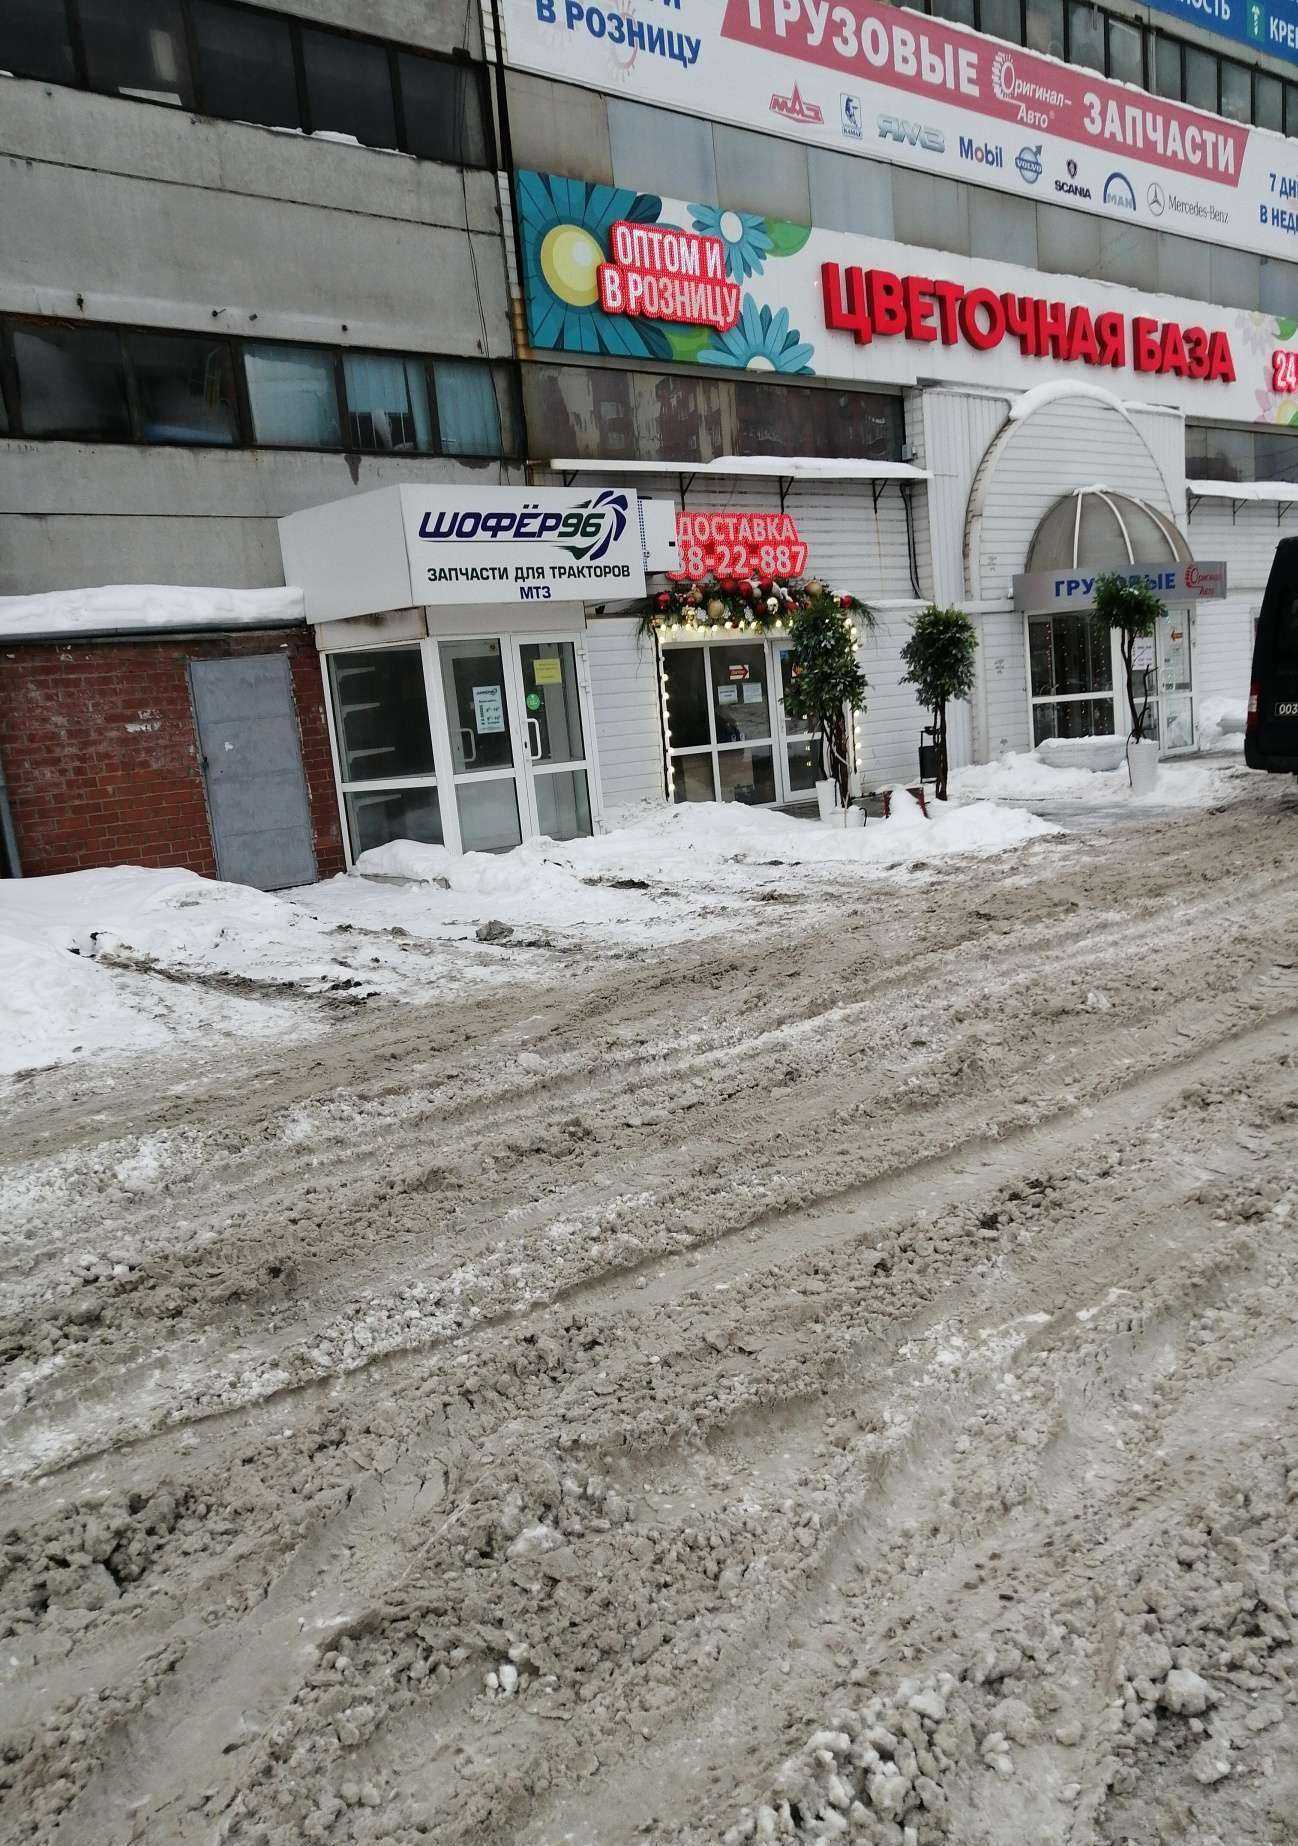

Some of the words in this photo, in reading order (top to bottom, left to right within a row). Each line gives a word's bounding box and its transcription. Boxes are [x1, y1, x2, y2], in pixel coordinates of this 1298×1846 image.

[536, 0, 557, 24] В
[565, 0, 701, 68] РОЗНИЦУ
[1269, 16, 1298, 49] КРЕ
[748, 0, 980, 97] ГРУЗОВЫЕ
[1016, 103, 1048, 128] Авто
[1083, 92, 1235, 174] ЗАПЧАСТИ
[959, 136, 1003, 168] Mobil
[1016, 158, 1042, 174] VOLVO
[1054, 180, 1092, 199] SCANIA
[1106, 193, 1133, 209] MAN
[1269, 172, 1277, 192] 7
[1280, 176, 1298, 200] ДН
[1168, 194, 1229, 224] Mercedes-Benz
[1260, 204, 1268, 224] В
[1271, 207, 1298, 235] НЕД
[616, 226, 700, 276] ОПТОМ
[705, 241, 722, 279] И
[602, 267, 622, 308] В
[627, 272, 737, 326] РОЗНИЦУ
[821, 262, 1126, 368] ЦВЕТОЧНАЯ
[1132, 316, 1236, 383] БАЗА
[418, 504, 606, 539] ШОФЁР96
[678, 516, 796, 541] ДОСТАВКА
[427, 567, 509, 582] ЗАПЧАСТИ
[514, 566, 546, 582] ДЛЯ
[550, 565, 631, 579] ТРАКТОРОВ
[519, 586, 551, 600] МТЗ
